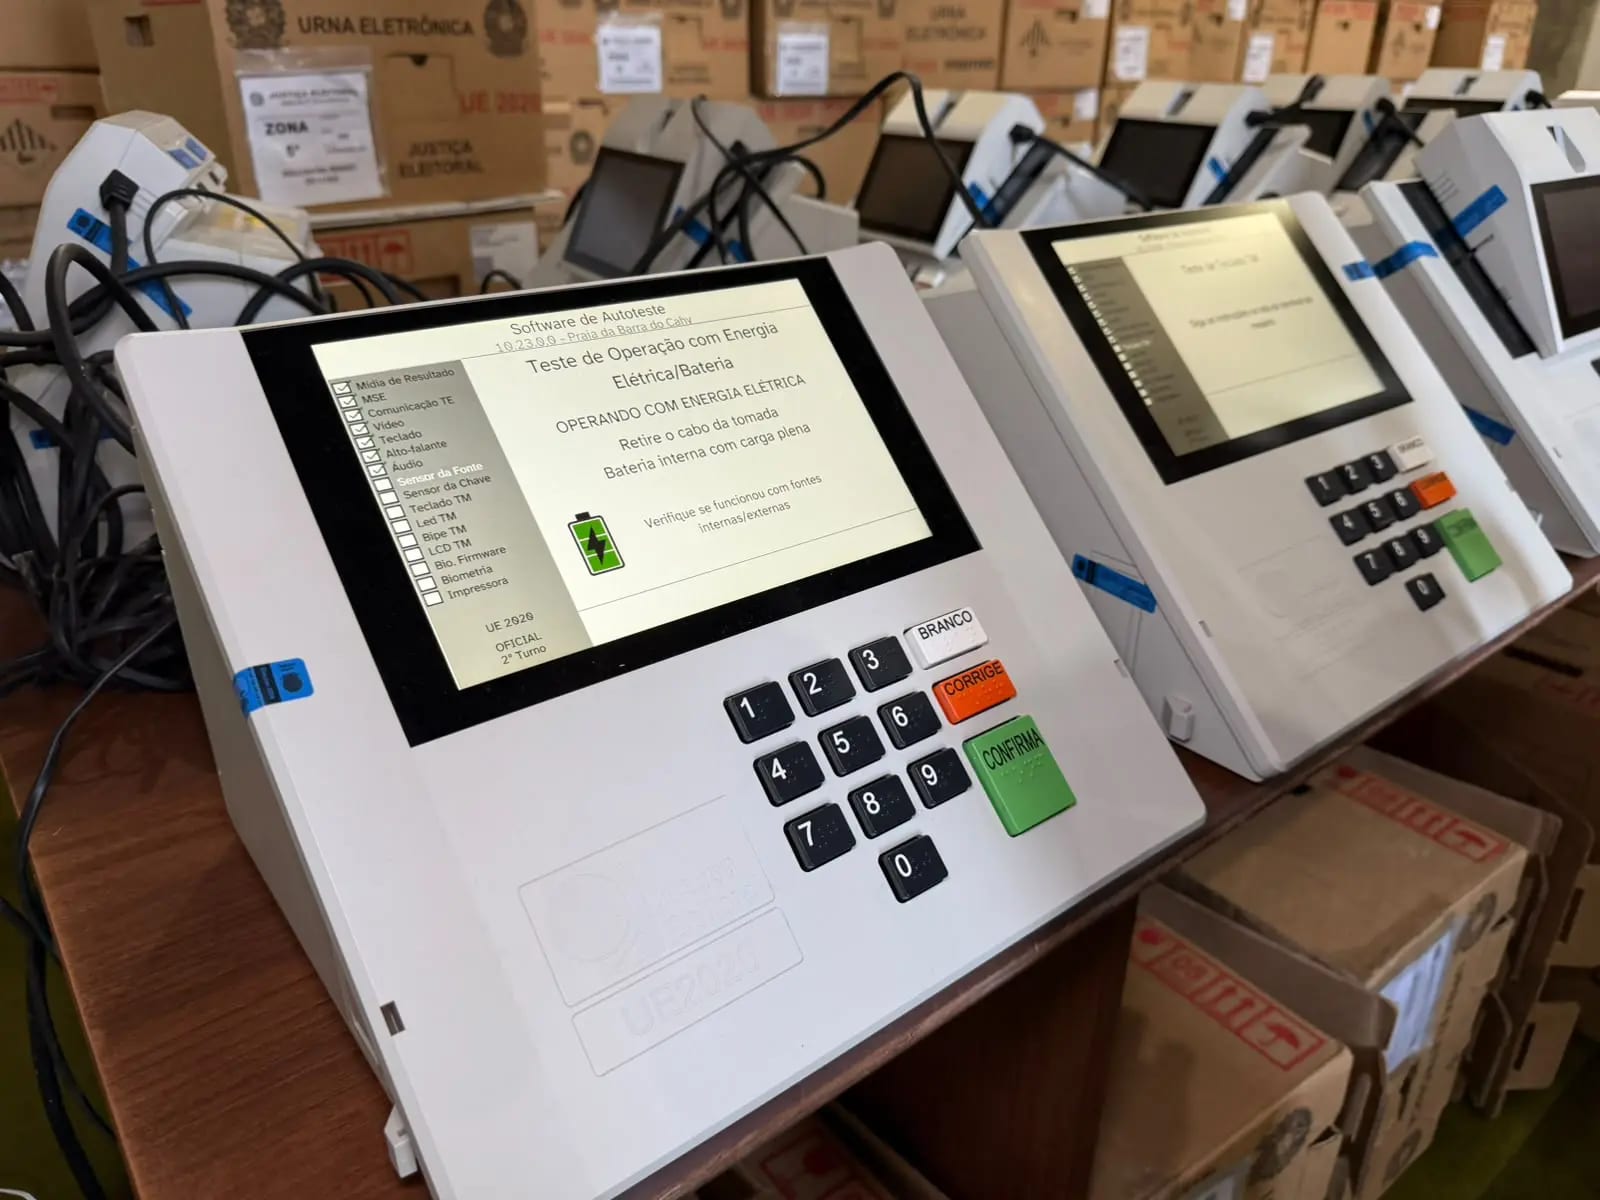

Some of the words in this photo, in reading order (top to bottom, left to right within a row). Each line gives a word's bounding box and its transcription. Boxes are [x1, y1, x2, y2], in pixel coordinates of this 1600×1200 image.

[297, 15, 355, 34] URNA
[359, 13, 475, 36] ELETRÔNICA
[460, 91, 489, 113] UE
[265, 121, 309, 136] ZONA
[510, 313, 578, 336] Software
[580, 313, 598, 326] de
[602, 304, 667, 323] Autoteste
[495, 335, 557, 354] 10.23.0.0
[568, 330, 598, 344] Praia
[600, 327, 616, 338] da
[617, 321, 648, 335] Barra
[650, 319, 664, 330] do
[525, 353, 578, 375] Teste
[582, 349, 604, 366] de
[607, 337, 685, 363] Operação
[688, 332, 722, 349] com
[723, 321, 779, 344] Energia
[389, 377, 402, 386] de
[404, 368, 455, 383] Resultado
[611, 356, 735, 390] Elétrica/Bateria
[361, 393, 387, 404] MSE
[368, 398, 438, 418] Comunicação
[440, 396, 455, 405] TE
[555, 406, 641, 435] OPERANDO
[643, 399, 680, 416] COM
[680, 387, 743, 410] ENERGIA
[744, 373, 807, 397] ELÉTRICA
[379, 430, 423, 445] Teclado
[619, 430, 662, 452] Retire
[665, 429, 675, 441] o
[677, 422, 710, 439] cabo
[712, 417, 730, 431] da
[731, 406, 780, 426] tomada
[386, 440, 448, 458] Alto-falante
[603, 456, 657, 480] Bateria
[657, 448, 707, 468] interna
[709, 440, 738, 456] com
[740, 431, 776, 448] carga
[777, 422, 812, 441] plena
[397, 472, 436, 487] Sensor
[438, 468, 451, 478] da
[454, 462, 484, 475] Fonte
[1318, 476, 1329, 490] 1
[1345, 466, 1358, 480] 2
[1371, 455, 1384, 469] 3
[403, 486, 441, 500] Sensor
[443, 481, 458, 491] da
[459, 475, 492, 488] Chave
[409, 499, 453, 514] Teclado
[454, 493, 473, 504] TM
[643, 507, 697, 530] Verifique
[699, 504, 714, 515] se
[713, 489, 766, 512] funcionou
[767, 484, 791, 498] com
[791, 474, 822, 489] fontes
[1343, 515, 1354, 529] 4
[1368, 503, 1381, 518] 5
[1394, 492, 1407, 506] 6
[416, 516, 437, 528] Led
[439, 512, 457, 523] TM
[698, 500, 791, 534] internas/externas
[423, 530, 448, 543] Bipe
[449, 525, 468, 536] TM
[428, 543, 452, 556] LCD
[453, 539, 473, 550] TM
[435, 557, 457, 570] Bio.
[457, 545, 508, 565] Firmware
[1364, 554, 1377, 570] 7
[1392, 541, 1405, 556] 8
[1417, 529, 1430, 544] 9
[441, 564, 494, 585] Biometria
[447, 576, 510, 600] Impressora
[1416, 580, 1429, 595] 0
[485, 619, 503, 633] UE
[503, 612, 535, 628] 2020
[918, 610, 974, 640] BRANCO
[495, 631, 543, 653] OFICIAL
[515, 645, 547, 660] Turno
[741, 697, 756, 718] 1
[803, 672, 822, 695] 2
[863, 650, 880, 670] 3
[944, 662, 1005, 696] CORRIGE
[771, 758, 787, 781] 4
[833, 730, 850, 754] 5
[892, 706, 909, 727] 6
[982, 727, 1045, 771] CONFIRMA
[797, 821, 816, 847] 7
[862, 791, 881, 815] 8
[921, 765, 938, 787] 9
[894, 854, 913, 877] 0
